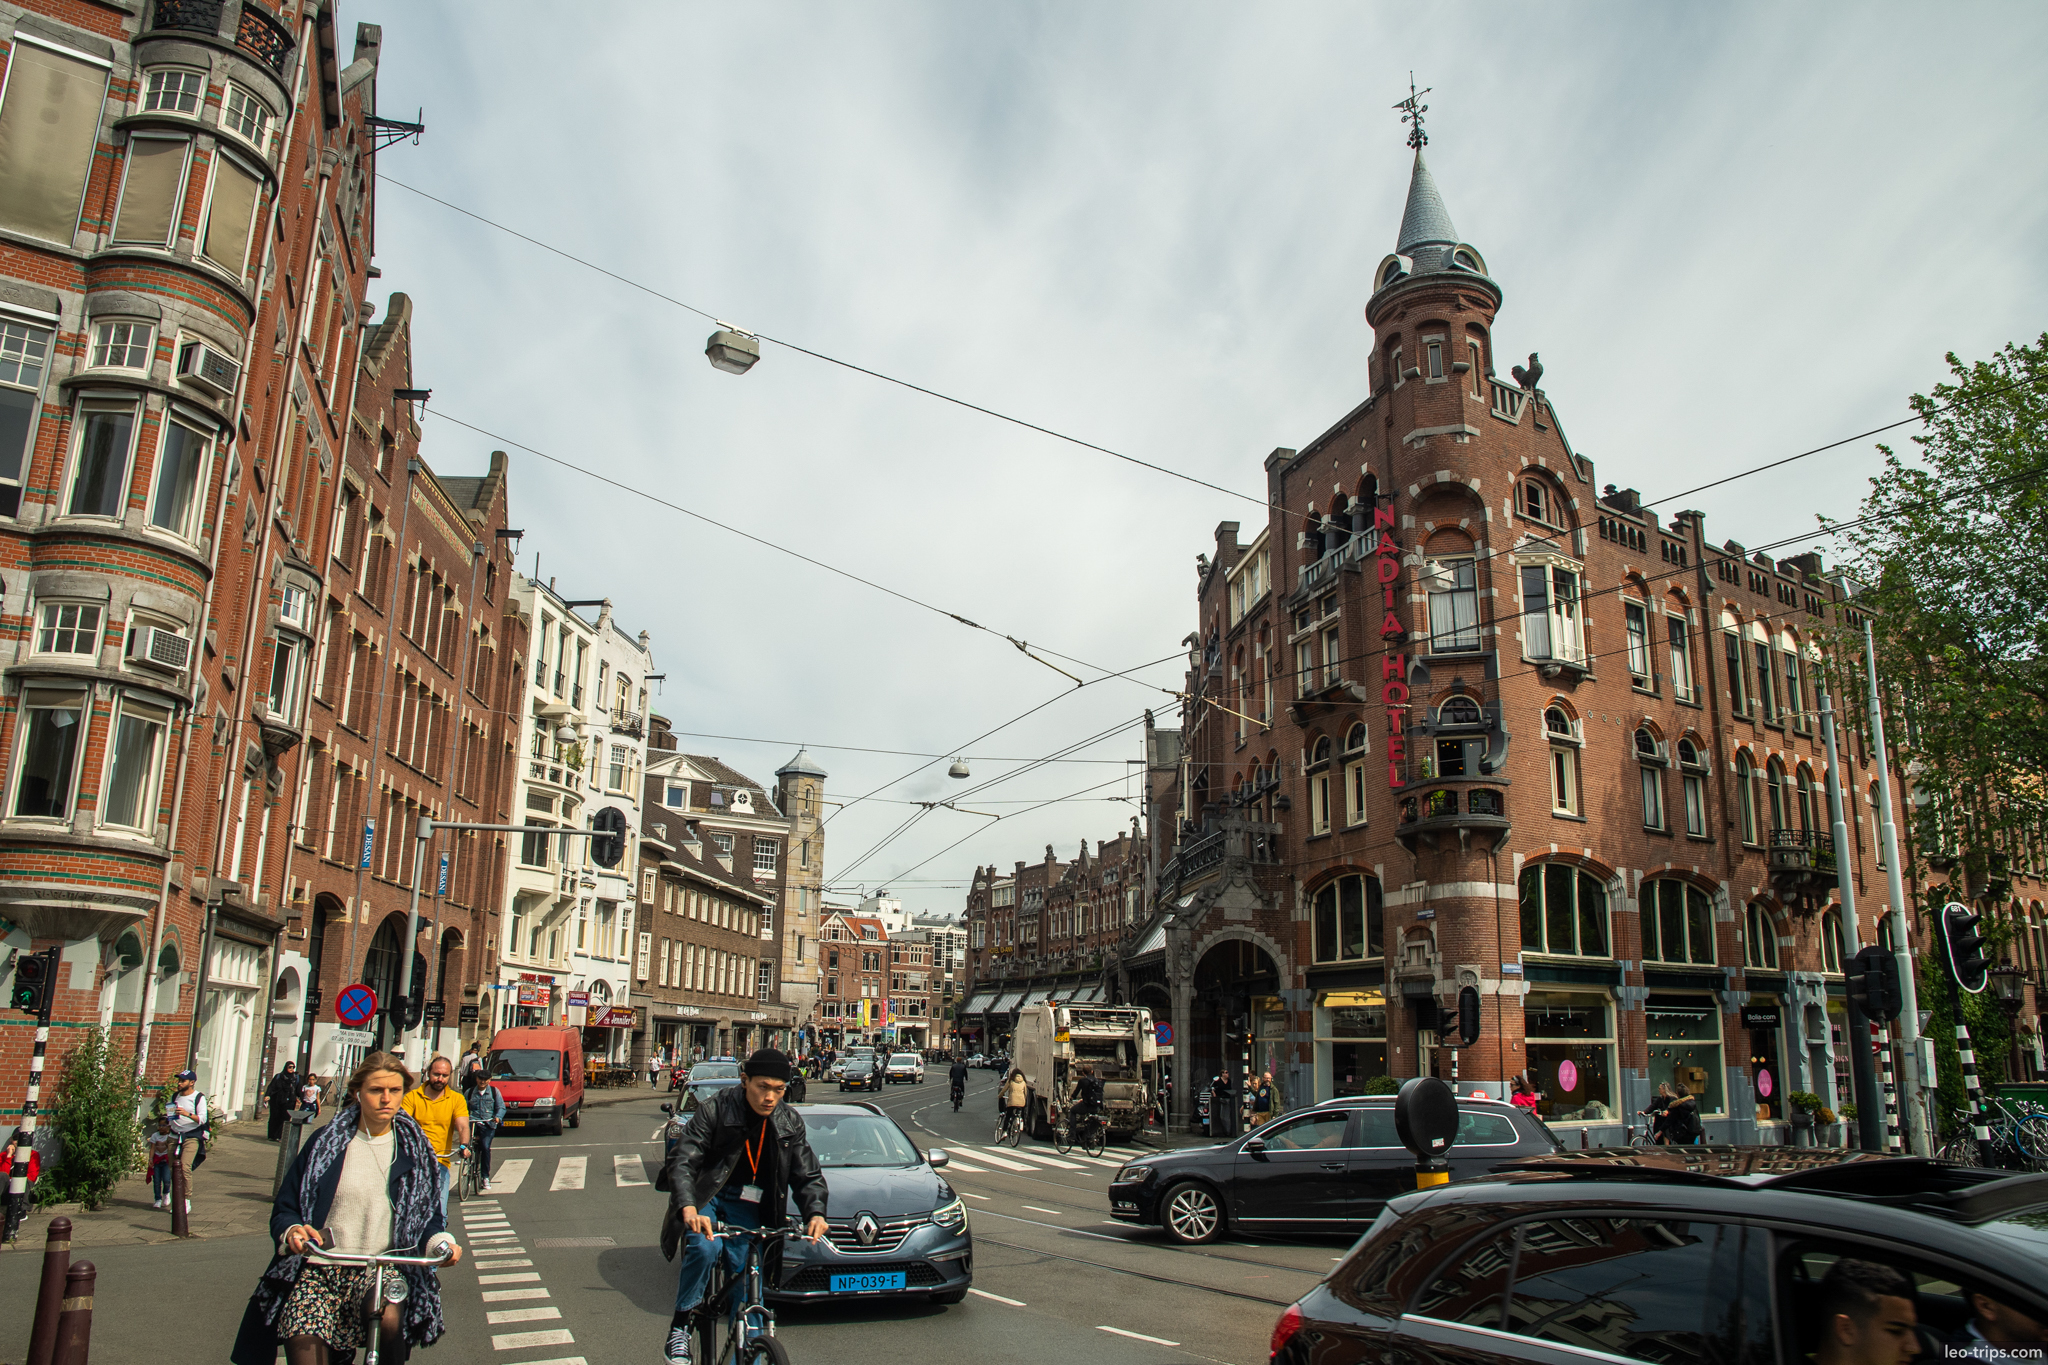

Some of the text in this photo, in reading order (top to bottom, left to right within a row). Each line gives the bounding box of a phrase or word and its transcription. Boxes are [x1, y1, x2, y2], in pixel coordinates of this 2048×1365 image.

[1374, 504, 1404, 635] NADIA
[1381, 654, 1409, 788] HOTEL
[363, 833, 373, 863] DESAN
[439, 865, 448, 891] DESAN
[611, 1014, 631, 1025] Jennifer
[839, 1275, 898, 1289] NP-039-F
